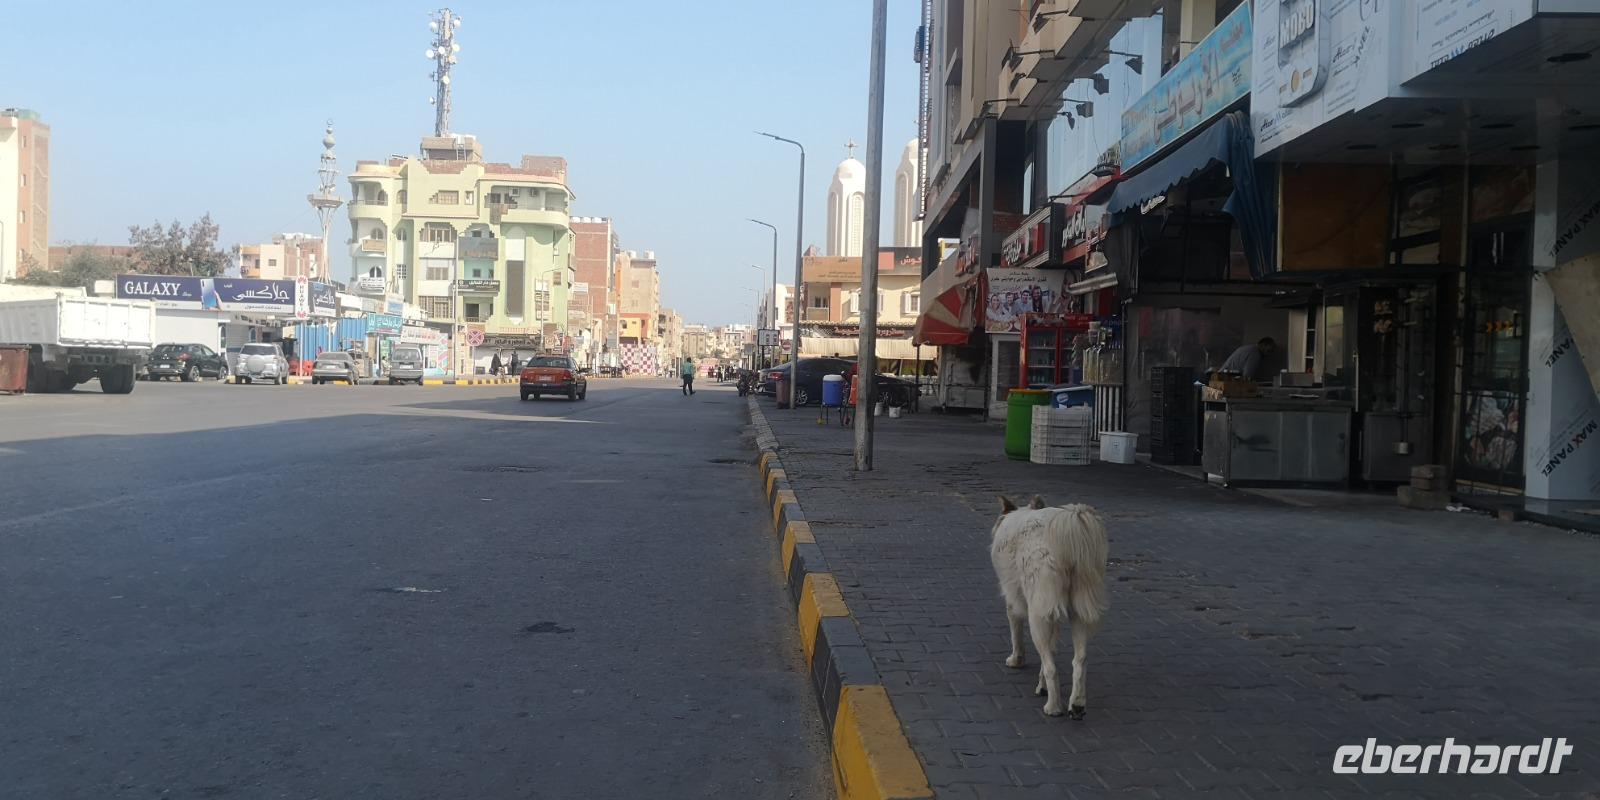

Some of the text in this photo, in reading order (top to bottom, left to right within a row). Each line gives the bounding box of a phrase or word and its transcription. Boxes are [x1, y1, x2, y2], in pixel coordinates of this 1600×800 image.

[1548, 223, 1581, 257] PANEL
[124, 281, 181, 296] GALAXY
[298, 285, 306, 310] HUAWEI
[1545, 338, 1575, 368] ANEL
[1572, 419, 1599, 449] MAX
[1541, 442, 1574, 477] PANEL
